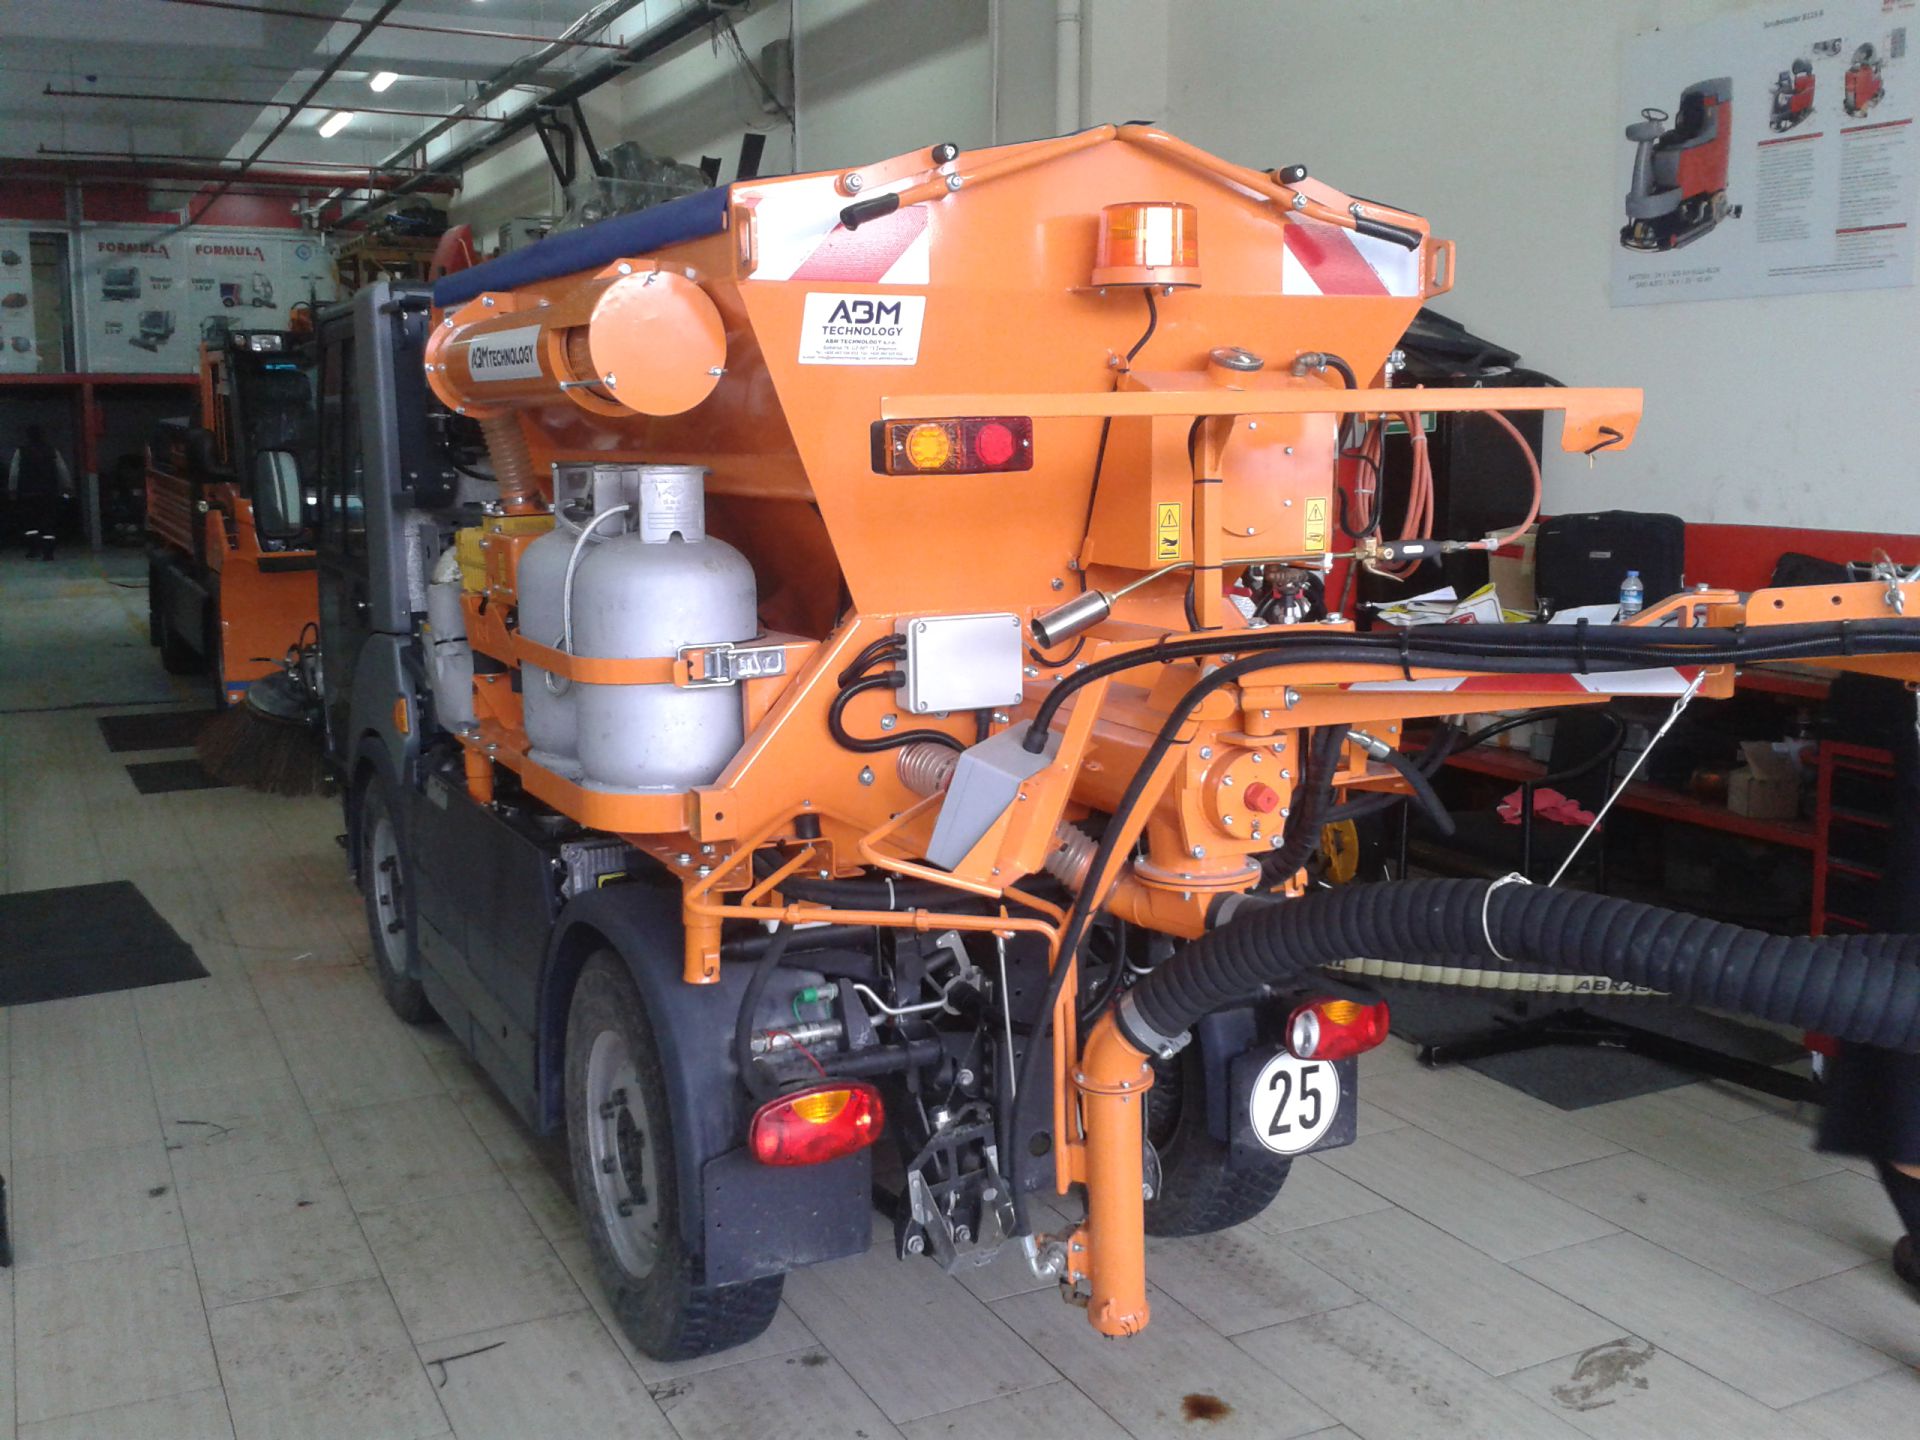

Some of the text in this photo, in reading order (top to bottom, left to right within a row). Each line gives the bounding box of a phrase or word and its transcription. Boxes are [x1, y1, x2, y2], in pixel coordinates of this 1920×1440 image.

[98, 242, 170, 260] FORMULA
[195, 244, 265, 262] FORMULA
[827, 299, 902, 324] ABM
[822, 325, 904, 336] TECHNOLOGY
[471, 345, 534, 369] ABM TECHNOLOGY
[1268, 1064, 1321, 1136] 25
